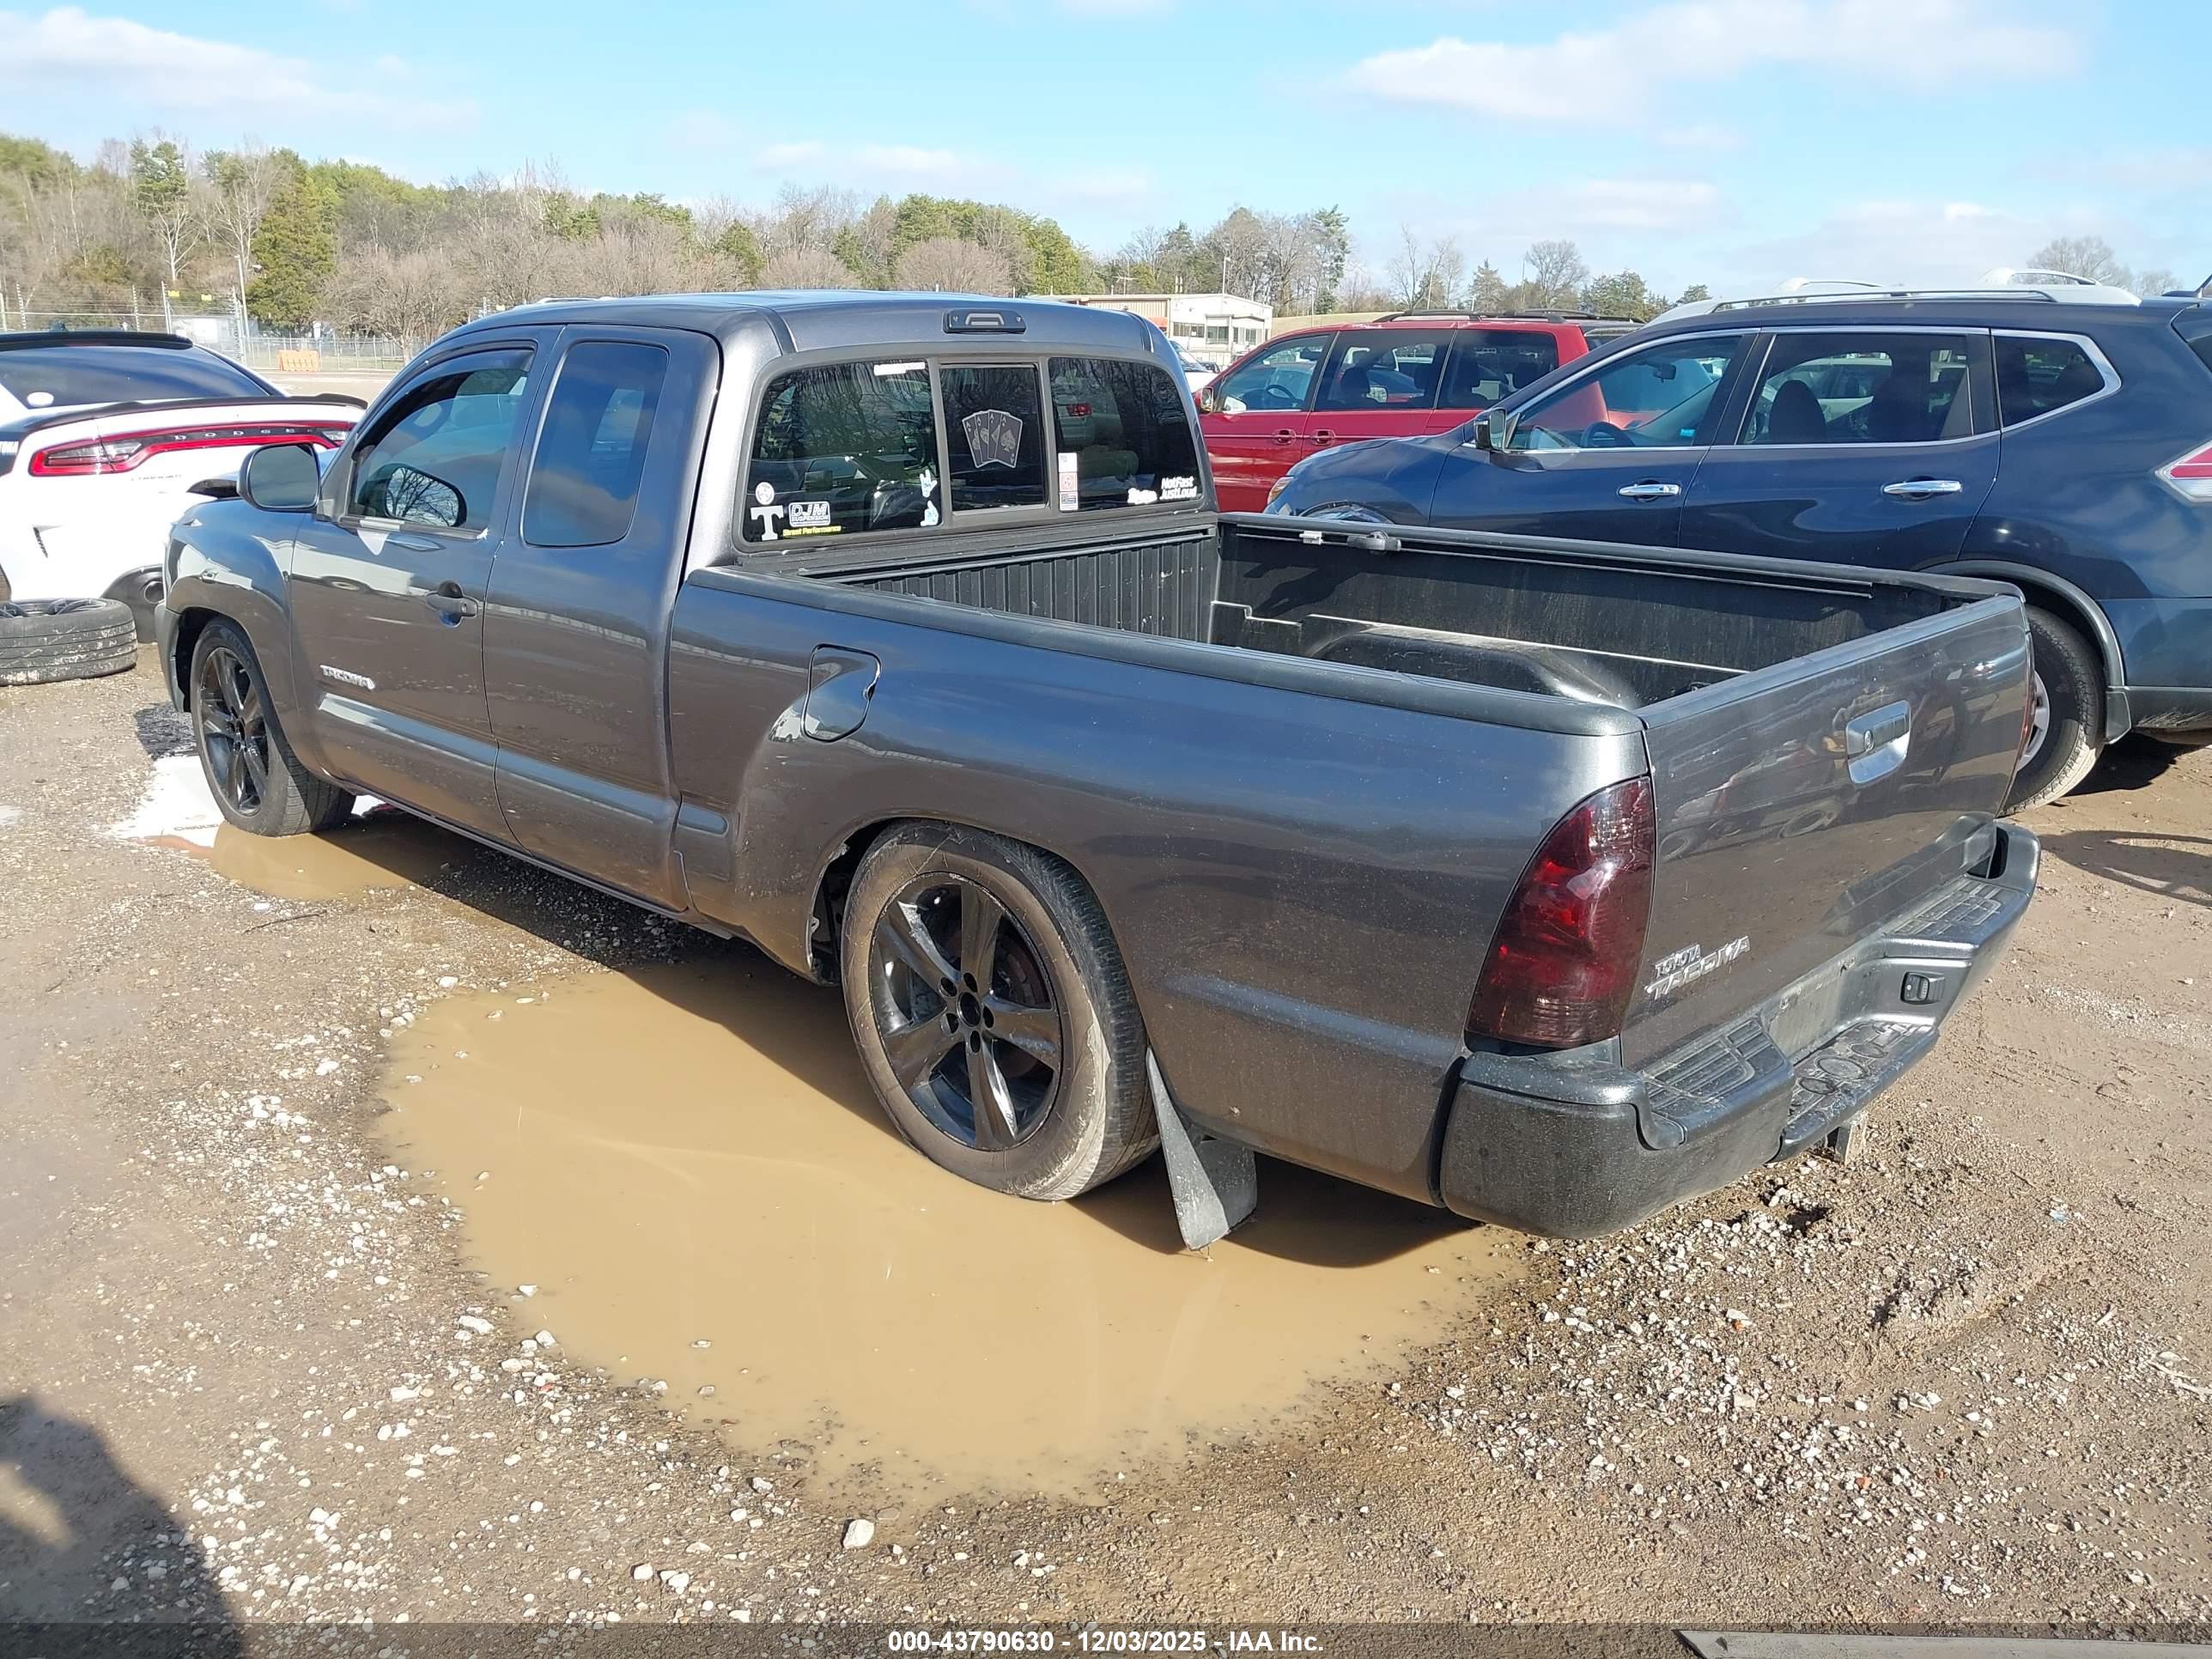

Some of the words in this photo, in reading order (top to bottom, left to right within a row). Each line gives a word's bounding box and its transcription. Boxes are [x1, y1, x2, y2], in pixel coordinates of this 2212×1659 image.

[174, 428, 295, 441] DODGE
[750, 505, 783, 541] T
[791, 503, 828, 517] DJM
[319, 664, 375, 690] TACOMA
[1644, 935, 1751, 1000] TACOMA
[1655, 944, 1701, 979] TOYOTA
